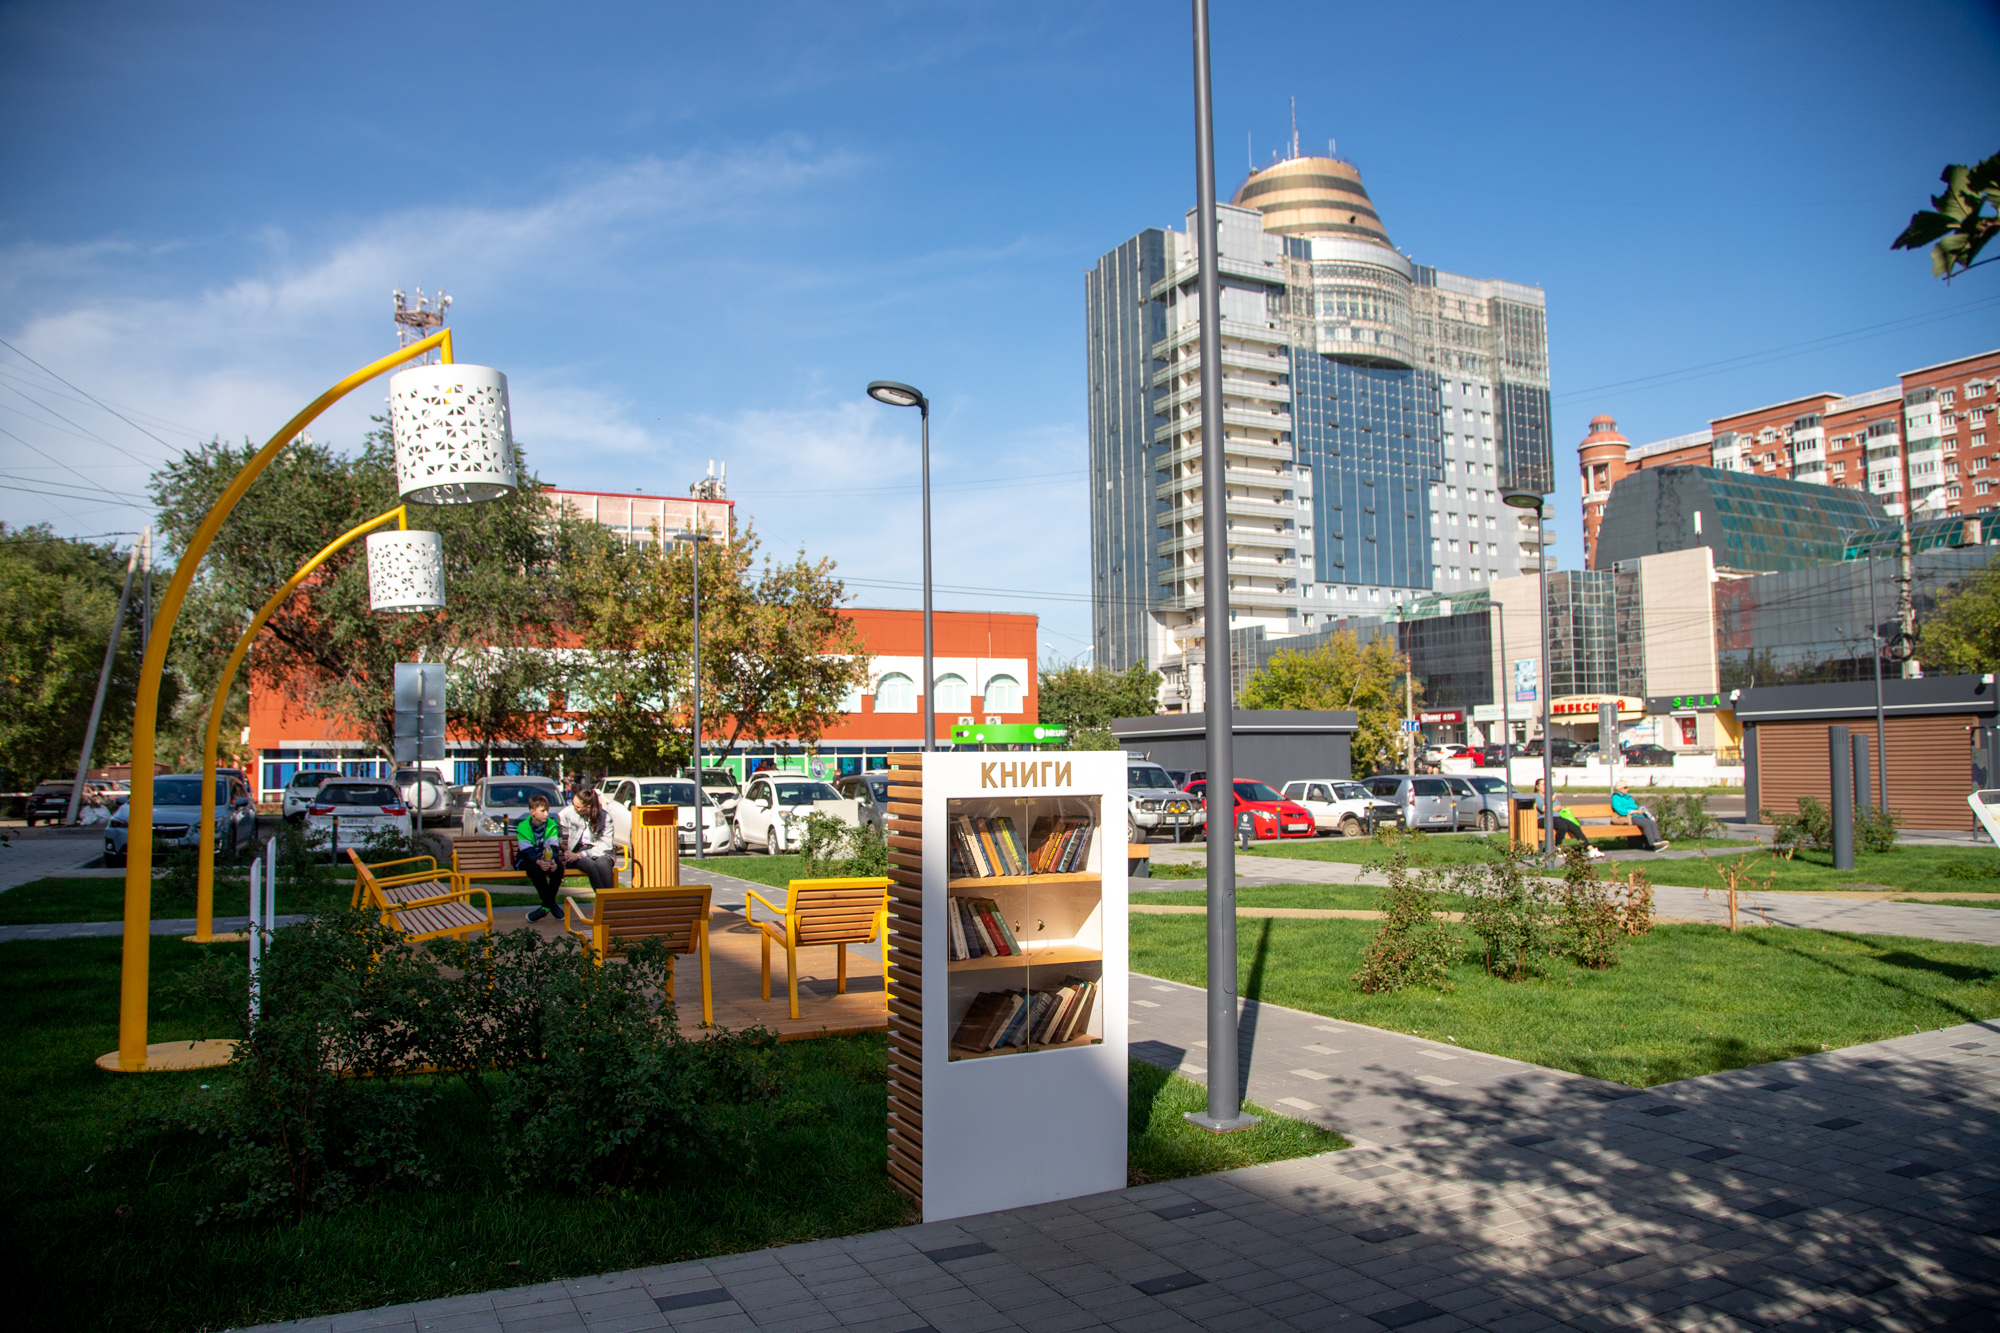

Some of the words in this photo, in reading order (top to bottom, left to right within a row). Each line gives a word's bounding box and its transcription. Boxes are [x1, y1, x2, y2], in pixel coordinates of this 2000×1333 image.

[1553, 699, 1626, 714] НЕБЕСНЙ
[1672, 695, 1721, 707] SELA
[981, 761, 1072, 788] КНИГИ
